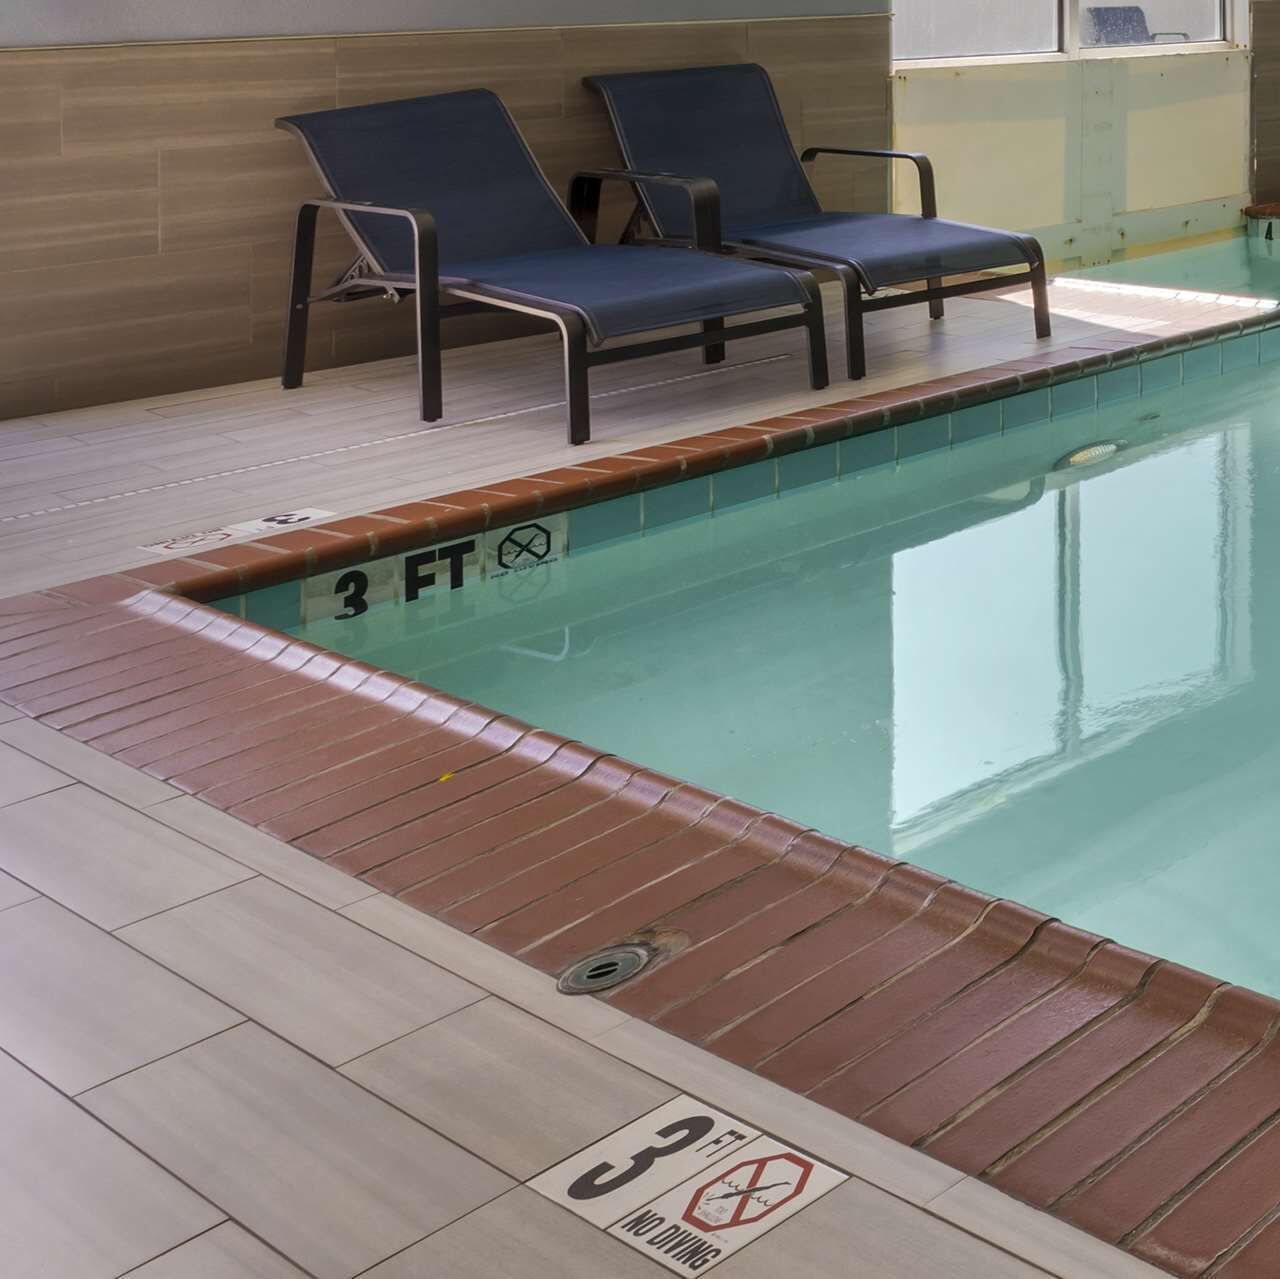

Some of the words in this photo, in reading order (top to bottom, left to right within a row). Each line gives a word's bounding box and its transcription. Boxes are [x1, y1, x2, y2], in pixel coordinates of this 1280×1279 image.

[1265, 222, 1273, 241] 4
[334, 570, 369, 620] 3
[404, 539, 476, 603] FT
[567, 1115, 715, 1200] 3
[696, 1130, 748, 1158] FT
[620, 1209, 666, 1236] NO
[646, 1224, 722, 1271] DIVING
